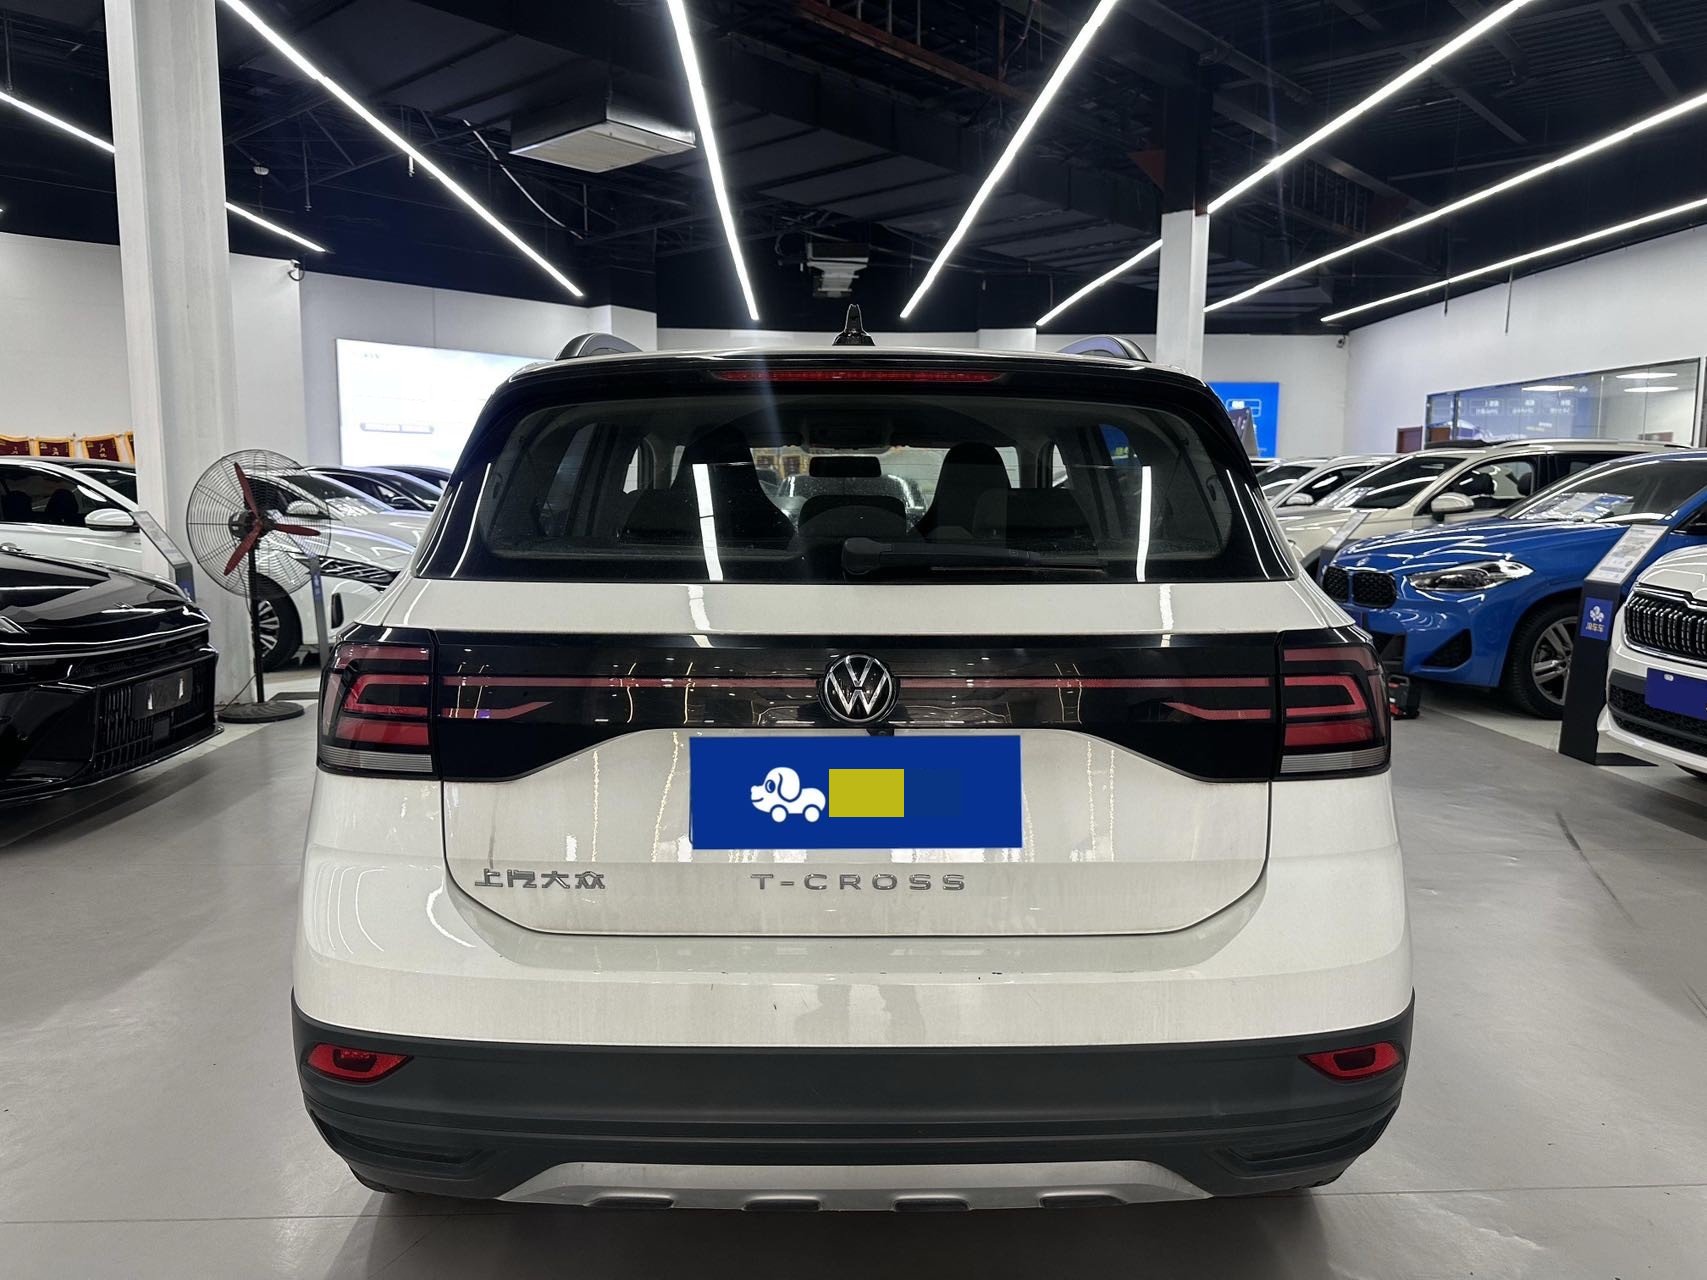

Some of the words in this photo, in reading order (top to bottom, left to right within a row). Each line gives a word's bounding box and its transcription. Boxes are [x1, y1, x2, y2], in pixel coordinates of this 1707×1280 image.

[474, 868, 605, 889] 上汽大众
[750, 873, 965, 890] T-CROSS
